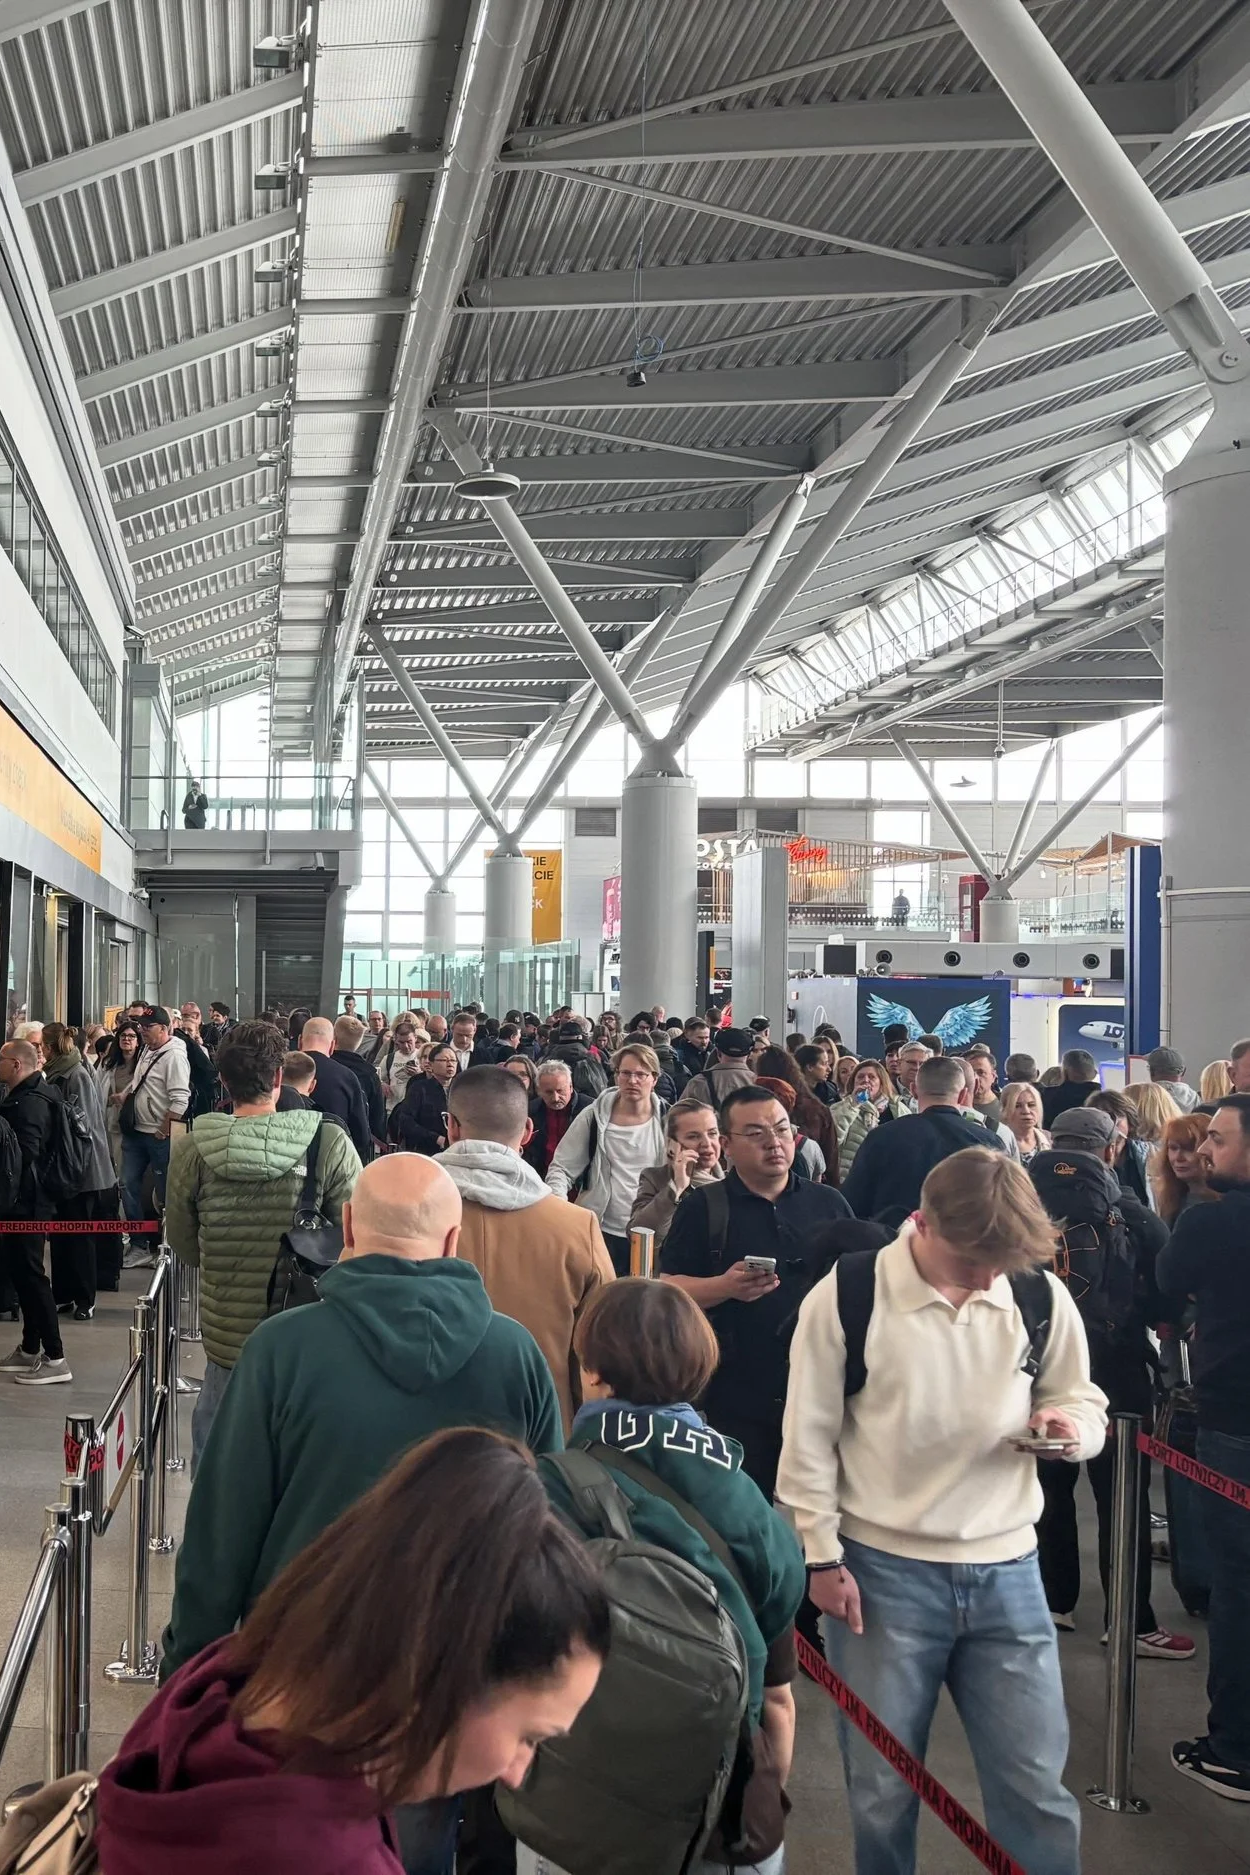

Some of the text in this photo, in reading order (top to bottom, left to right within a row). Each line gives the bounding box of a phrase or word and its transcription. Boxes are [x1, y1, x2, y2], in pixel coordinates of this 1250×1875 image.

[0, 1222, 50, 1231] FREDERIC
[53, 1222, 94, 1231] CHOPIN
[97, 1222, 145, 1231] AIRPORT
[1147, 1440, 1173, 1463] PORT
[1175, 1458, 1228, 1493] LOTNICZY
[866, 1711, 942, 1811] FRYDERYKA
[943, 1797, 1012, 1875] CHOPINA
